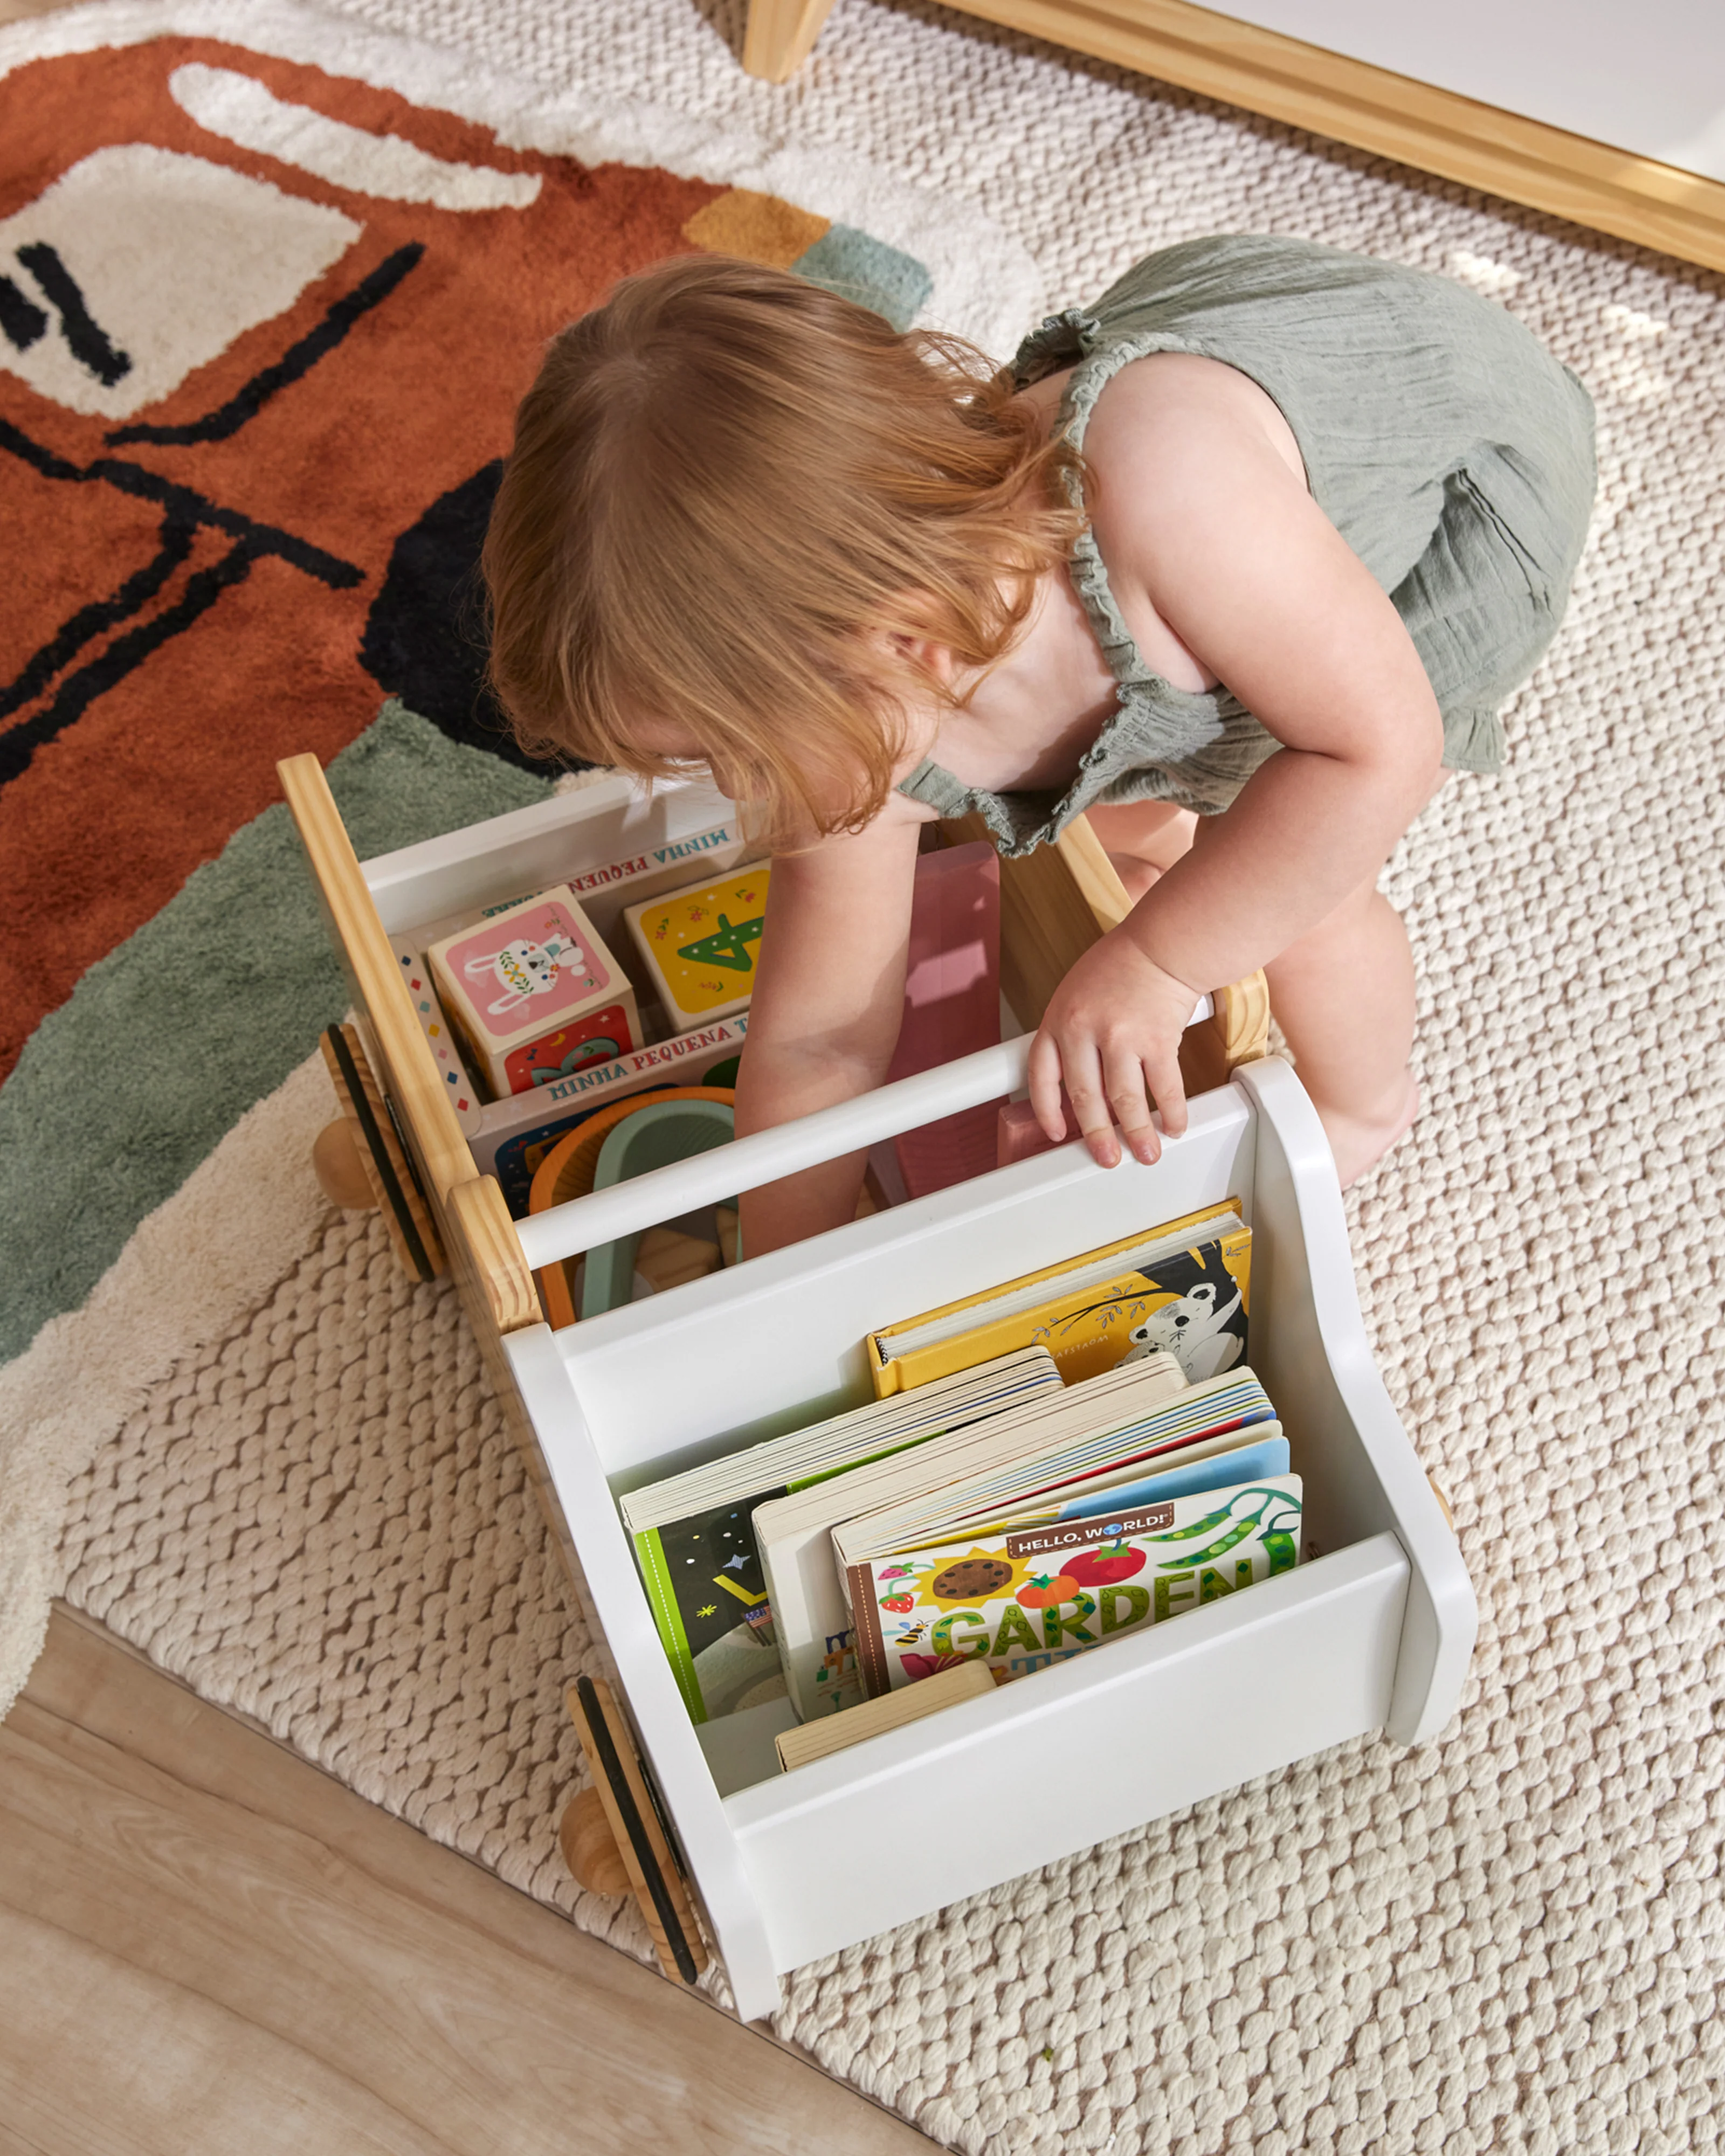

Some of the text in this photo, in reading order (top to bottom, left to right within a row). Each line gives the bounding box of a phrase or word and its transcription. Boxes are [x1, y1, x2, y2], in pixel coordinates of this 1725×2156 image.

[554, 828, 730, 894] MINHA PEQUEN
[547, 1063, 628, 1101] MINHA
[631, 1026, 732, 1072] PEQUENA
[1018, 1532, 1082, 1553] HELLO,
[931, 1558, 1253, 1660] GARDEN
